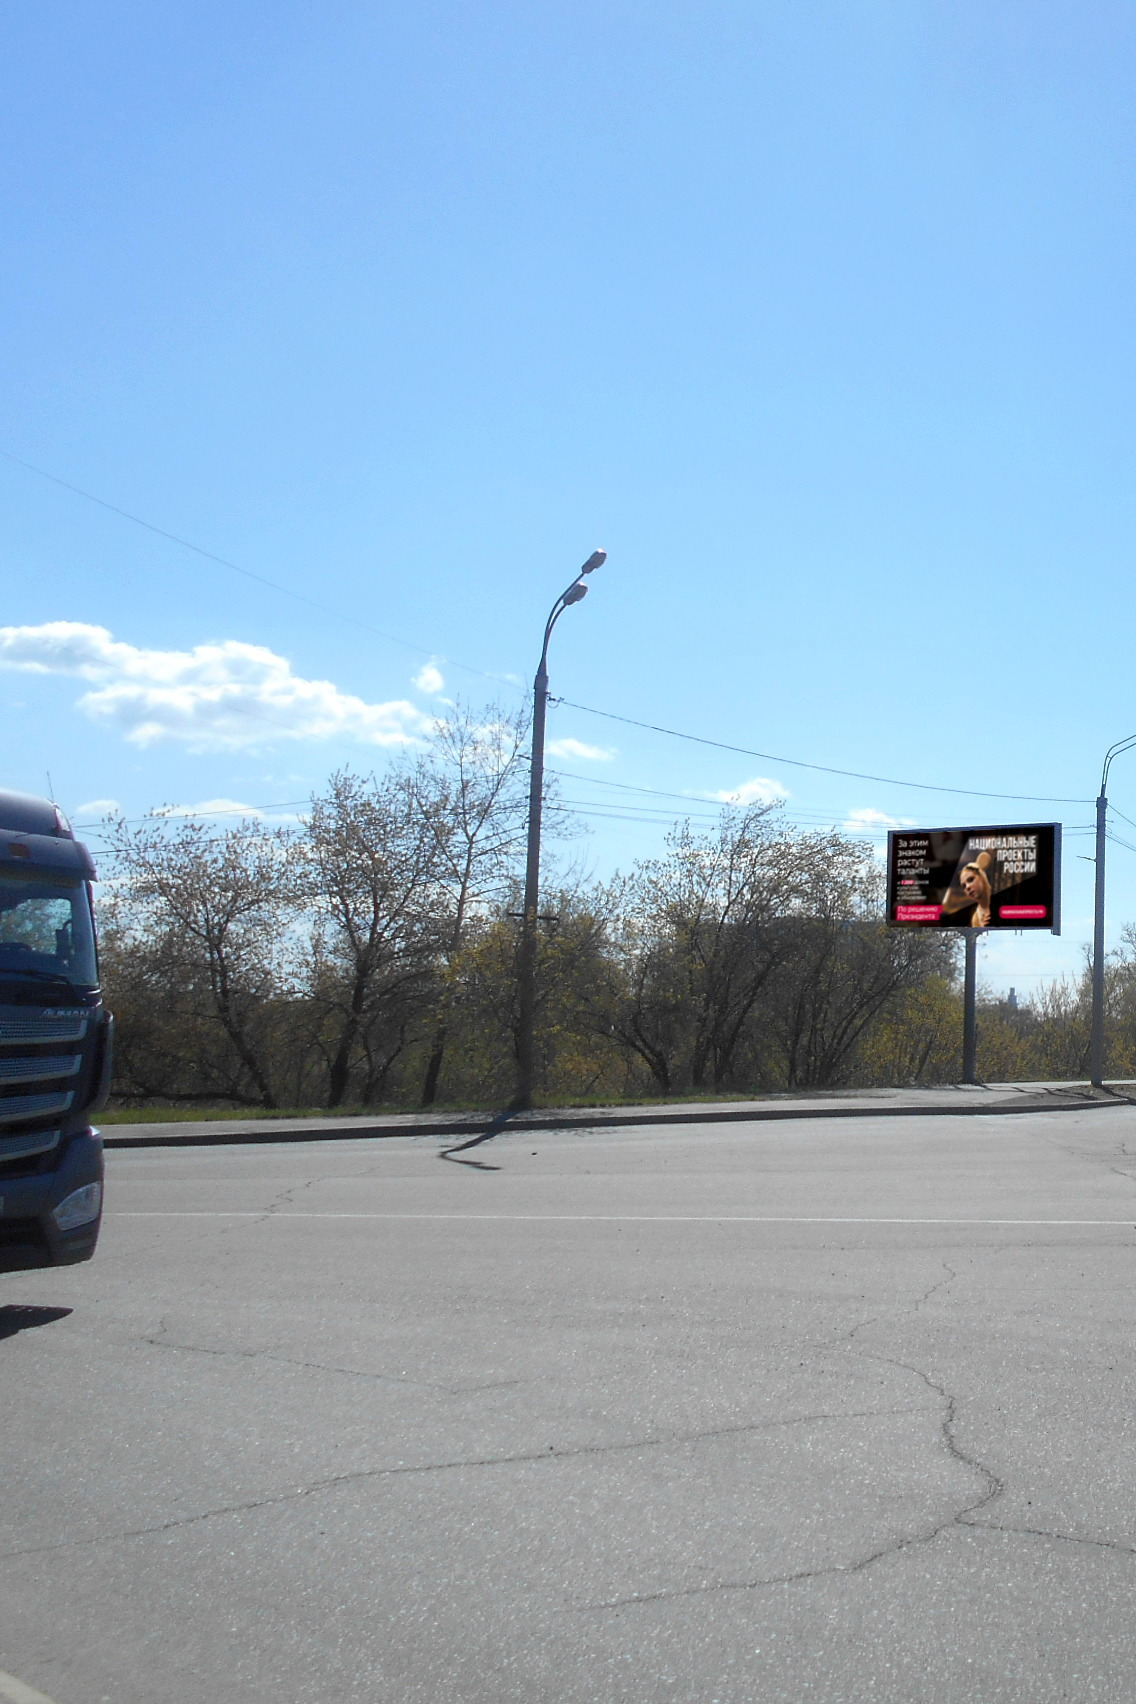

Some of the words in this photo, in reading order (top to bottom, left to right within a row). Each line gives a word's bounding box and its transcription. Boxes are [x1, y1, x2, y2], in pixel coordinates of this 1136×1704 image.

[968, 835, 1037, 850] НАЦИОНАЛЬНЫЕ
[996, 848, 1037, 861] ПРОЕКТЫ
[1003, 861, 1037, 873] РОССИИ
